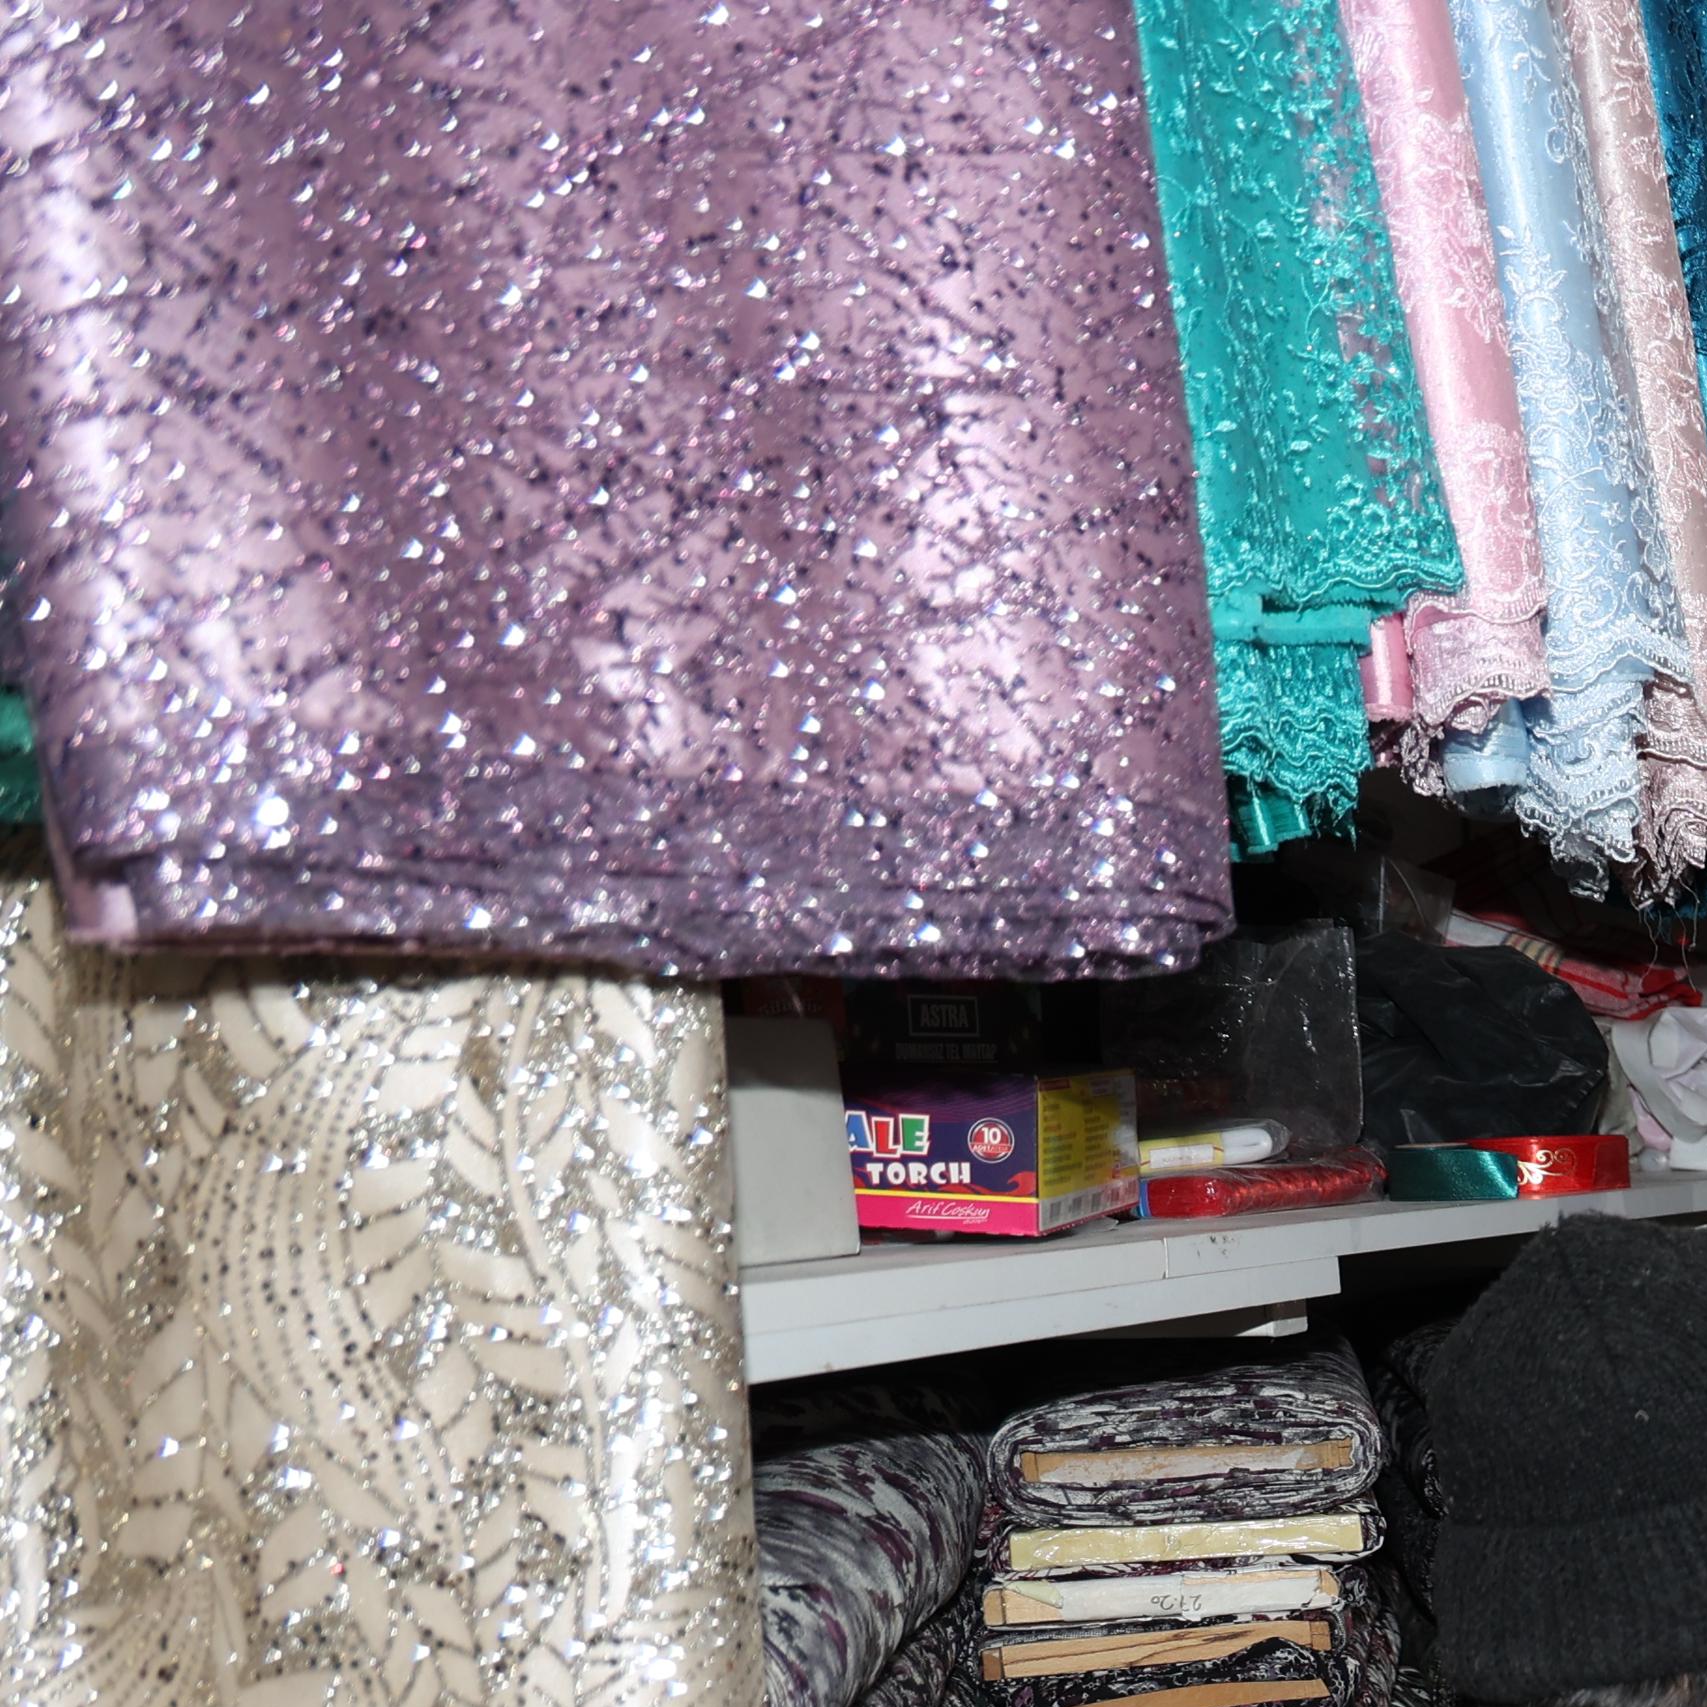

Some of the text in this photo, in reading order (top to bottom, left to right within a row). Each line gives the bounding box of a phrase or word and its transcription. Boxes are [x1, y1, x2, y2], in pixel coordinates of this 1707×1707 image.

[920, 1003, 969, 1028] ASTRA
[845, 1110, 931, 1158] ALE
[981, 1127, 1002, 1145] 10
[866, 1162, 971, 1185] TORCH
[906, 1200, 943, 1215] Arif
